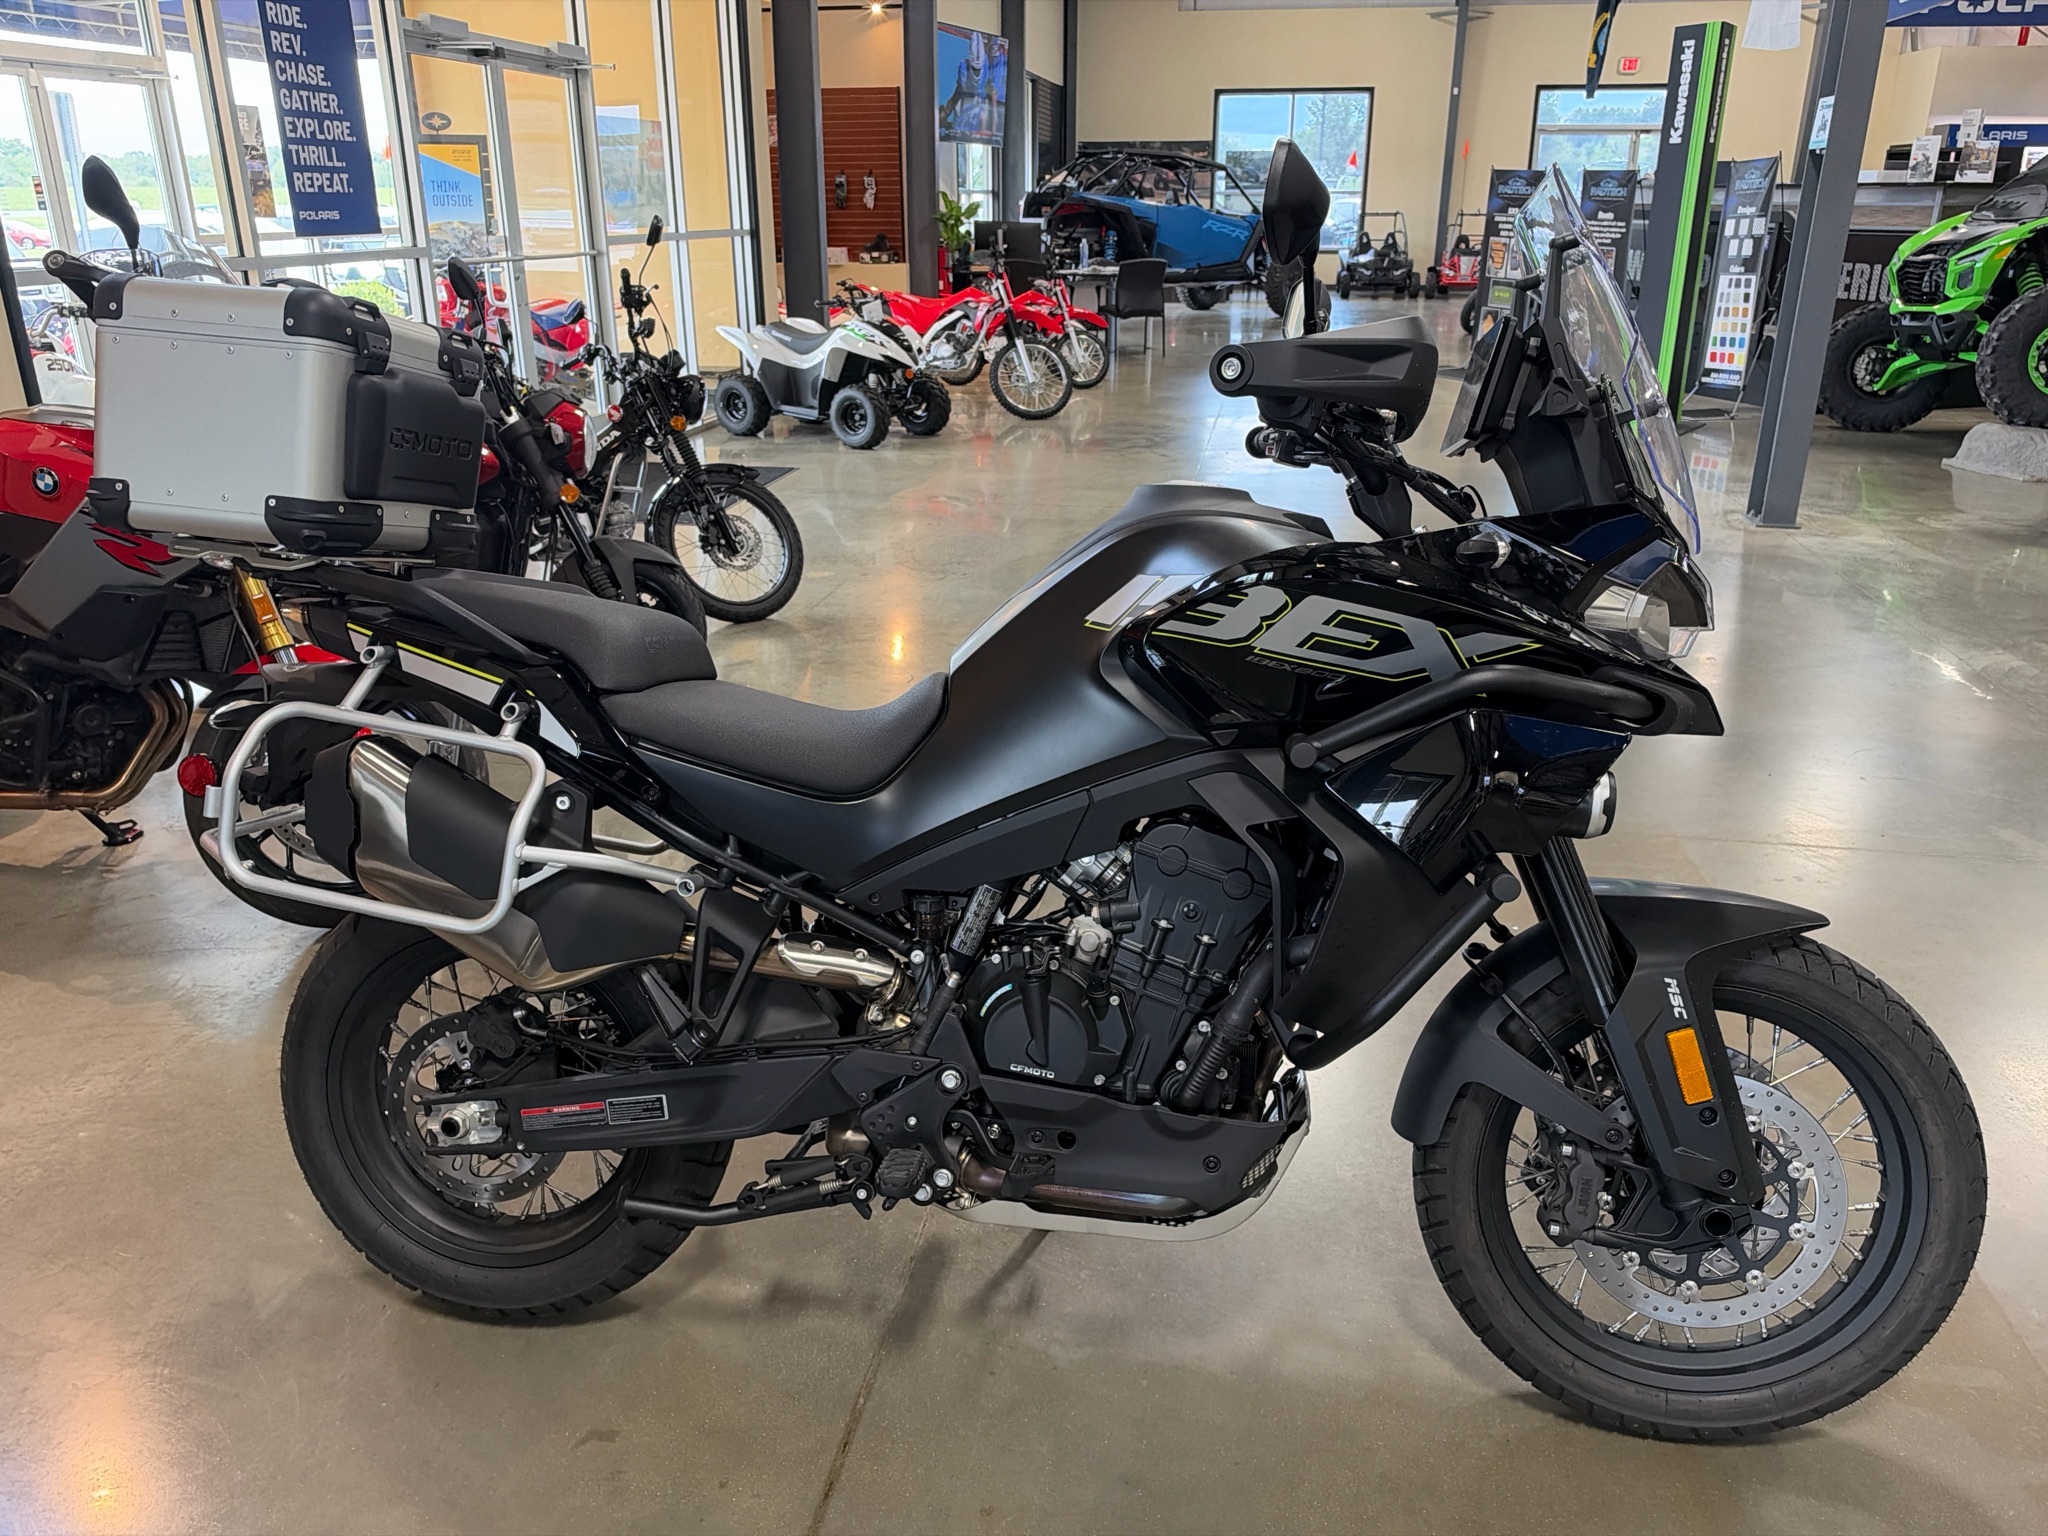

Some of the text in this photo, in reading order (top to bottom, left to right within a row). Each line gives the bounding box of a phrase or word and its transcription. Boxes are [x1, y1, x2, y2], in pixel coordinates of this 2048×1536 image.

[265, 1, 307, 29] RIDE.
[270, 30, 306, 56] REV.
[275, 59, 331, 87] CHASE.
[280, 88, 343, 115] GATHER.
[1669, 39, 1695, 144] Kawasaki
[284, 116, 356, 142] EXPLORE.
[1956, 131, 2028, 140] LARIS
[288, 144, 346, 167] THRILL.
[292, 172, 353, 193] REPEAT.
[430, 180, 461, 193] THINK
[432, 194, 474, 207] OUTSIDE
[299, 210, 340, 220] POLARIS
[1201, 219, 1249, 241] RZR
[389, 426, 473, 460] CFMOTO
[1245, 655, 1297, 671] IBEX
[1663, 977, 1688, 1019] MSC
[1009, 1063, 1055, 1079] CFMOTO
[553, 1105, 580, 1113] WARNING
